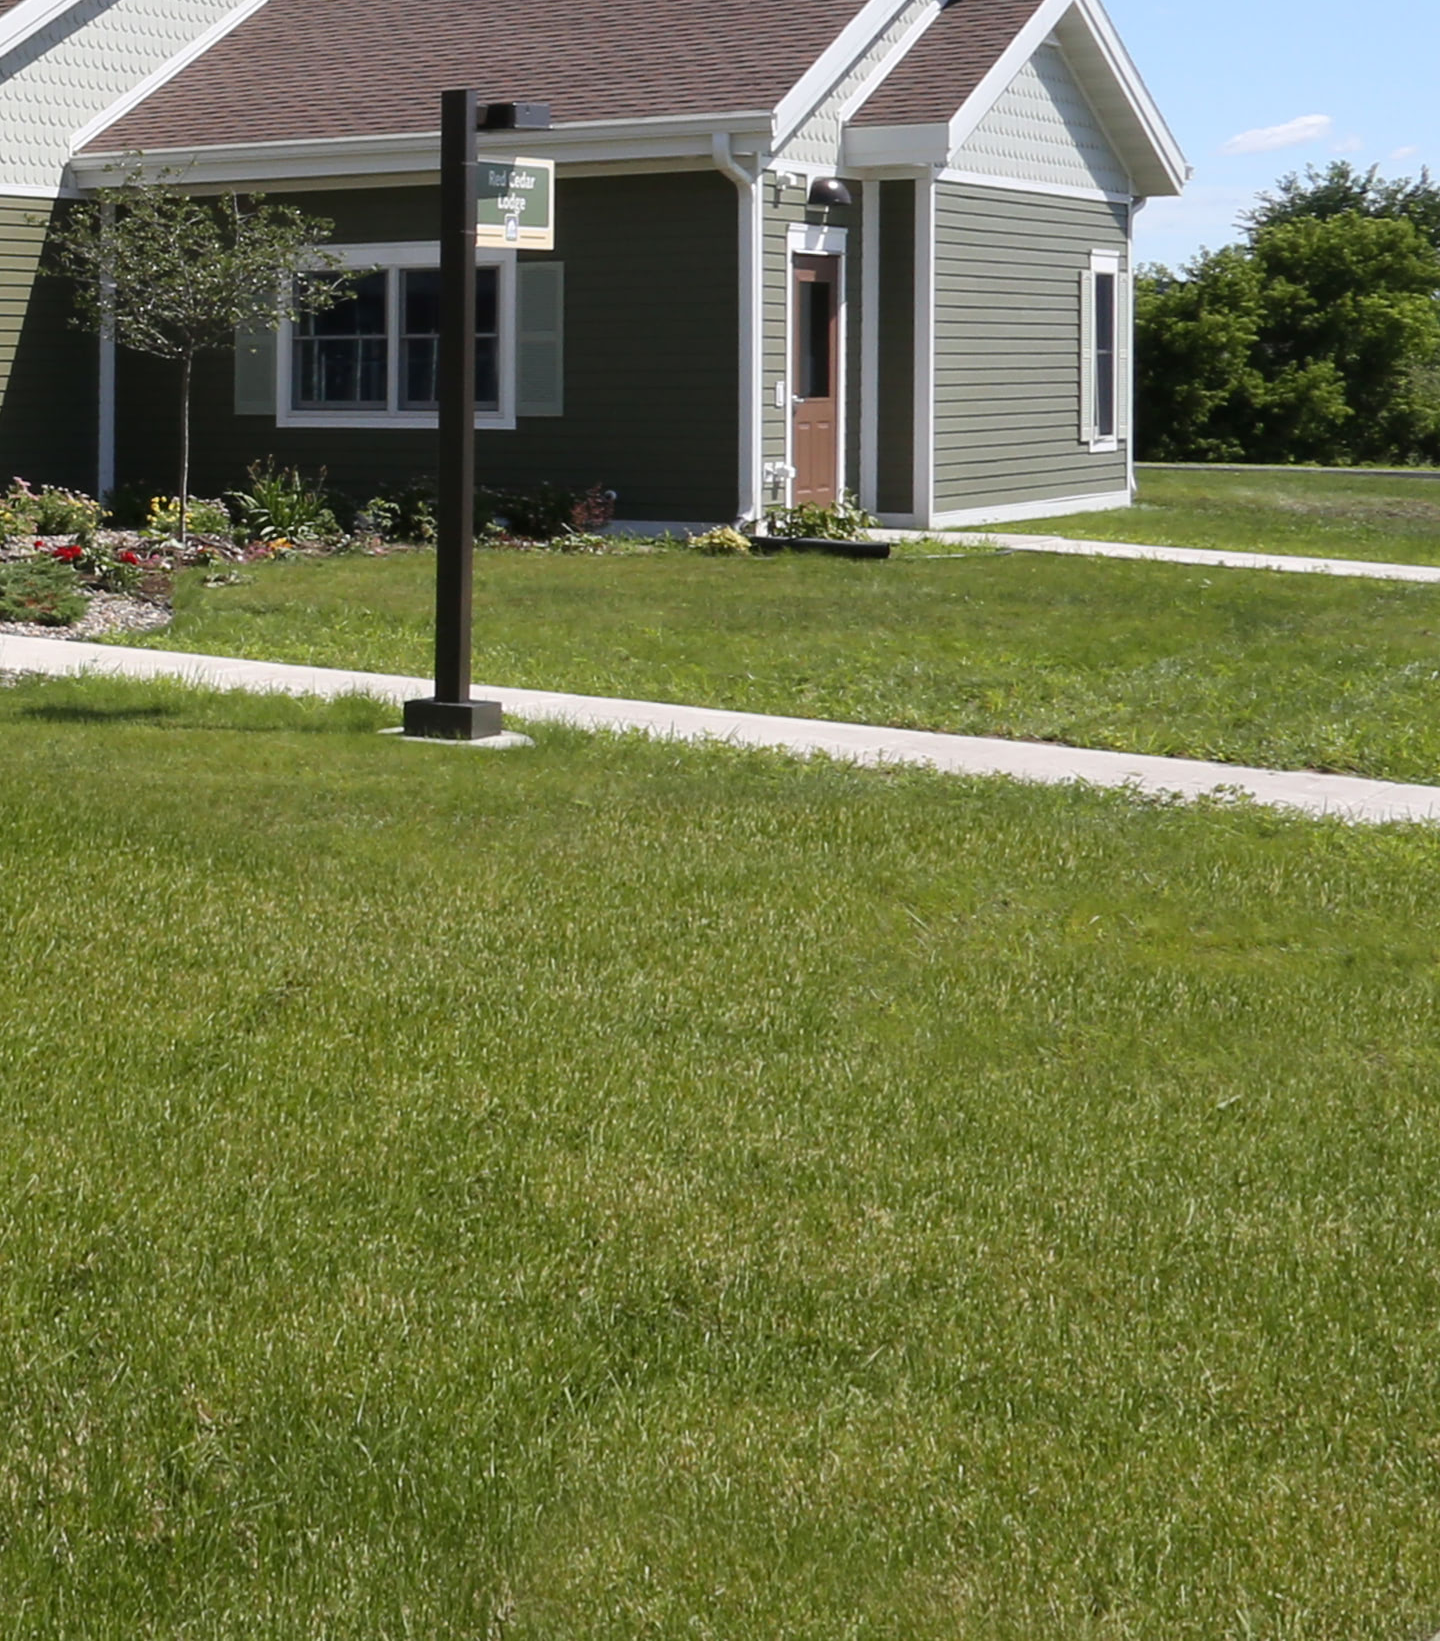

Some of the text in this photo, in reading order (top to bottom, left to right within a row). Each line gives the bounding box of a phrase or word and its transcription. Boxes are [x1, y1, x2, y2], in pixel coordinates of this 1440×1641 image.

[488, 170, 536, 189] Red Cedar
[497, 192, 526, 215] Lodge
